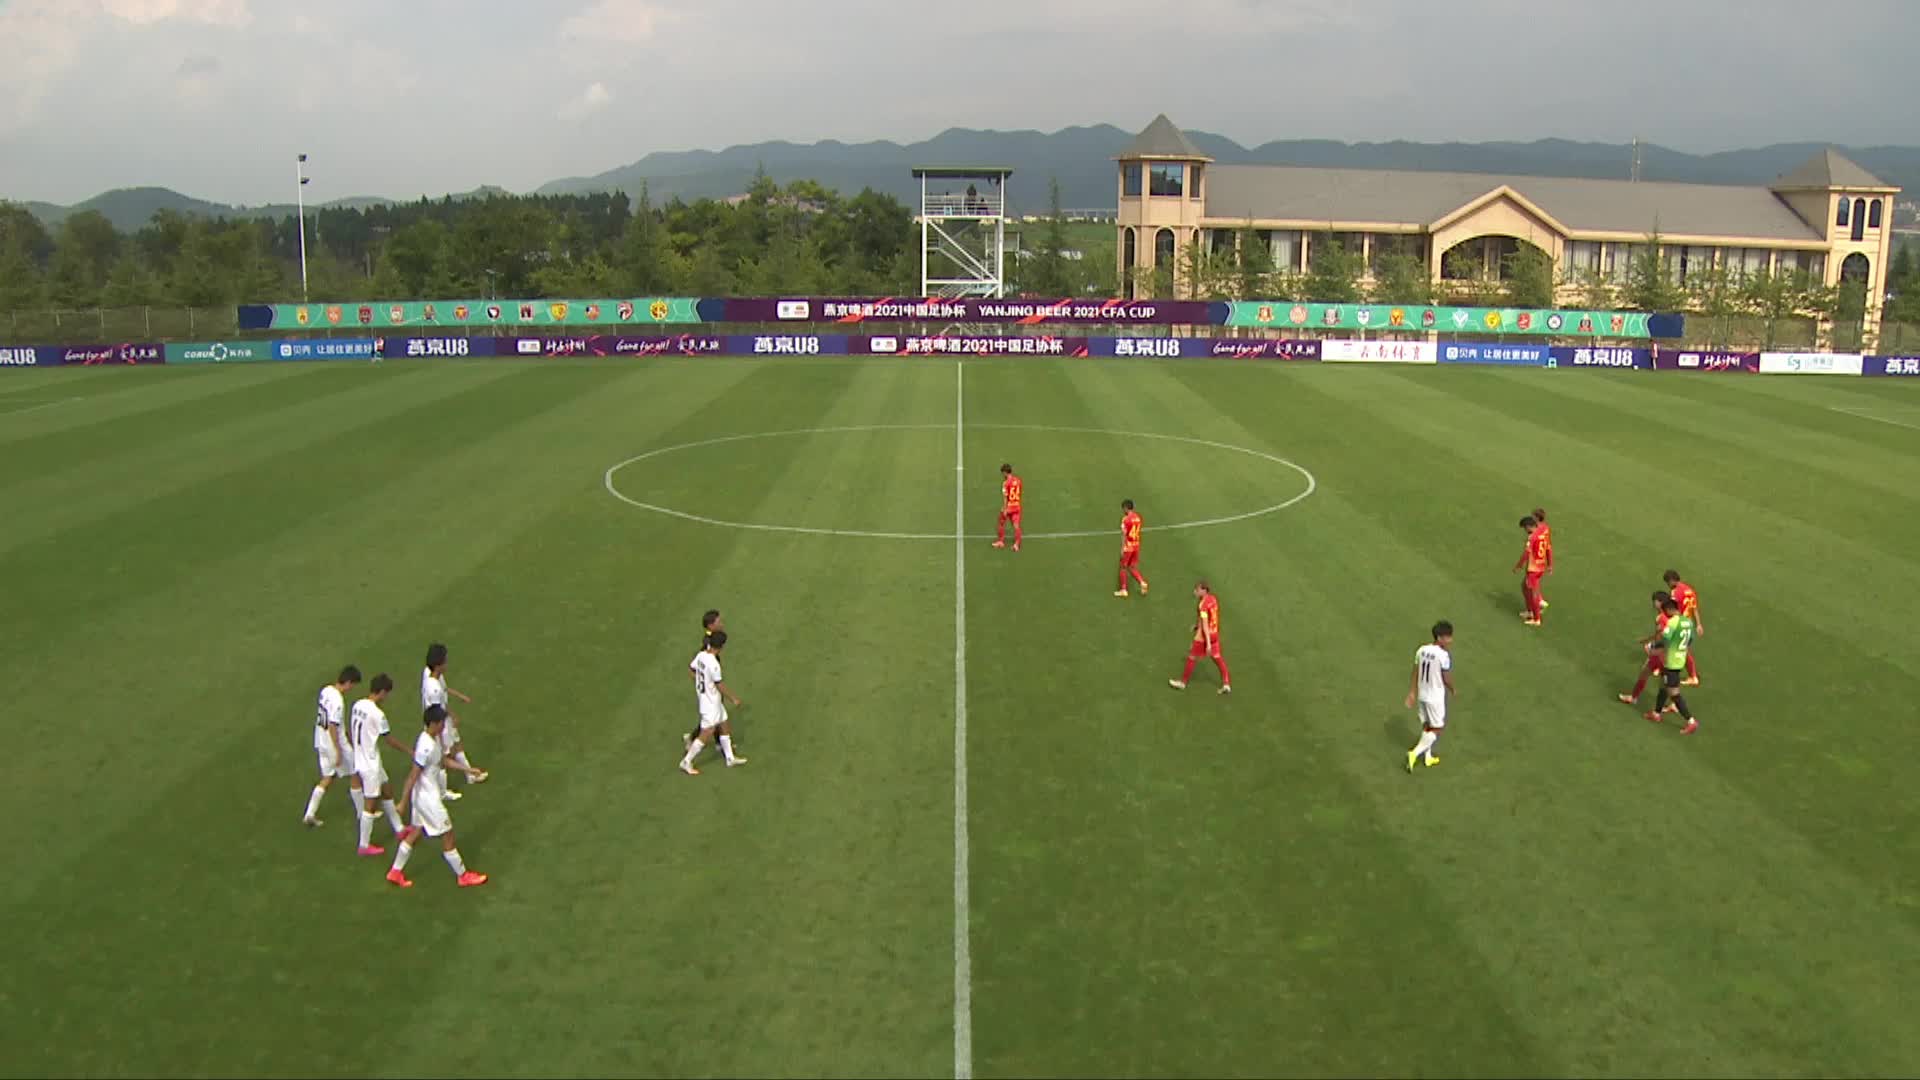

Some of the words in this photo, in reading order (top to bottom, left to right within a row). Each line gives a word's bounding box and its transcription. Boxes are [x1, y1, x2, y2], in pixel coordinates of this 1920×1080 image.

[824, 303, 966, 318] 燕京啤酒2021中国足协杯
[978, 305, 1033, 317] YANJING
[1036, 305, 1071, 317] BEER
[1074, 306, 1099, 318] 2021
[1101, 306, 1125, 318] CFA
[1129, 307, 1155, 319] CUP
[407, 339, 469, 356] 燕京U8
[754, 336, 819, 354] 燕京U8
[906, 337, 1064, 353] 燕京啤酒2021中国足协杯
[1115, 339, 1180, 356] 燕京U8
[1573, 348, 1633, 366] 燕京U8
